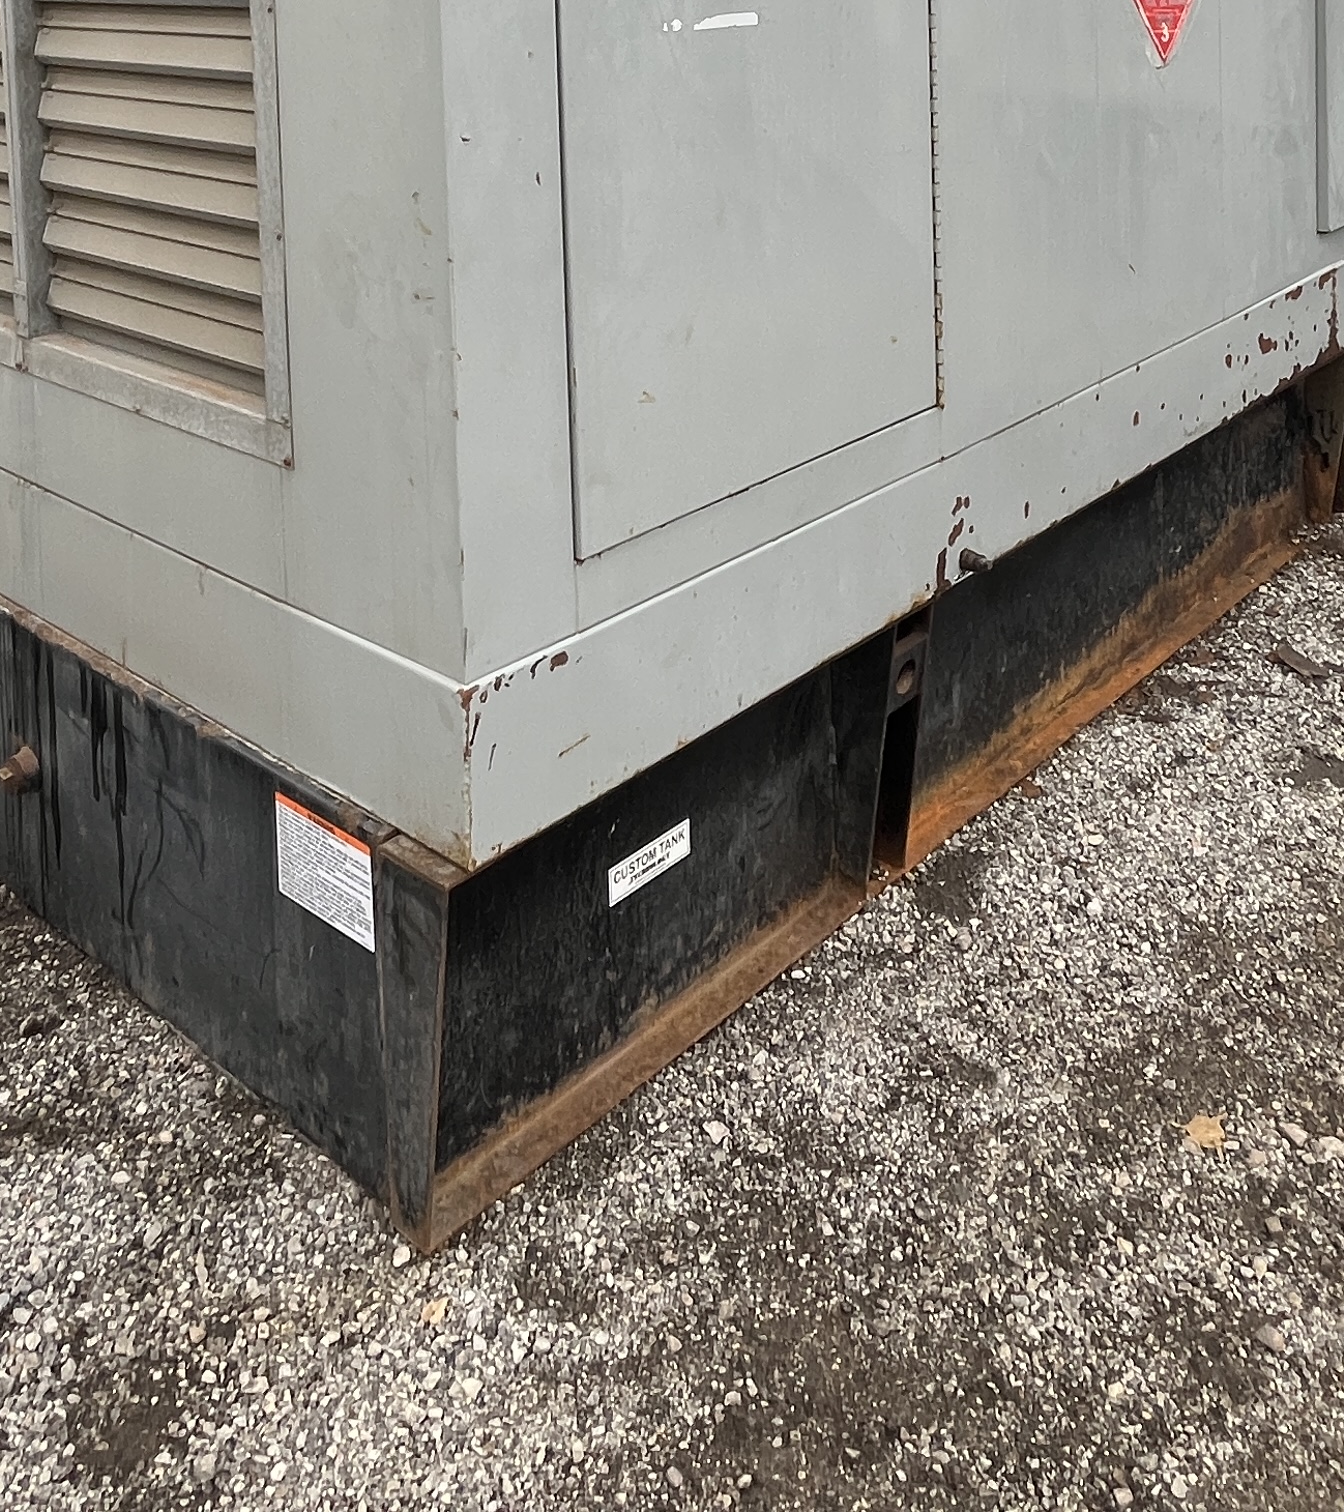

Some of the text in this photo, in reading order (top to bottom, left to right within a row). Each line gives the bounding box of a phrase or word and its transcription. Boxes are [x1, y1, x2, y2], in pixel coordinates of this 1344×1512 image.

[1160, 22, 1170, 42] 3
[613, 846, 657, 884] CUSTOM
[659, 828, 685, 854] TANK
